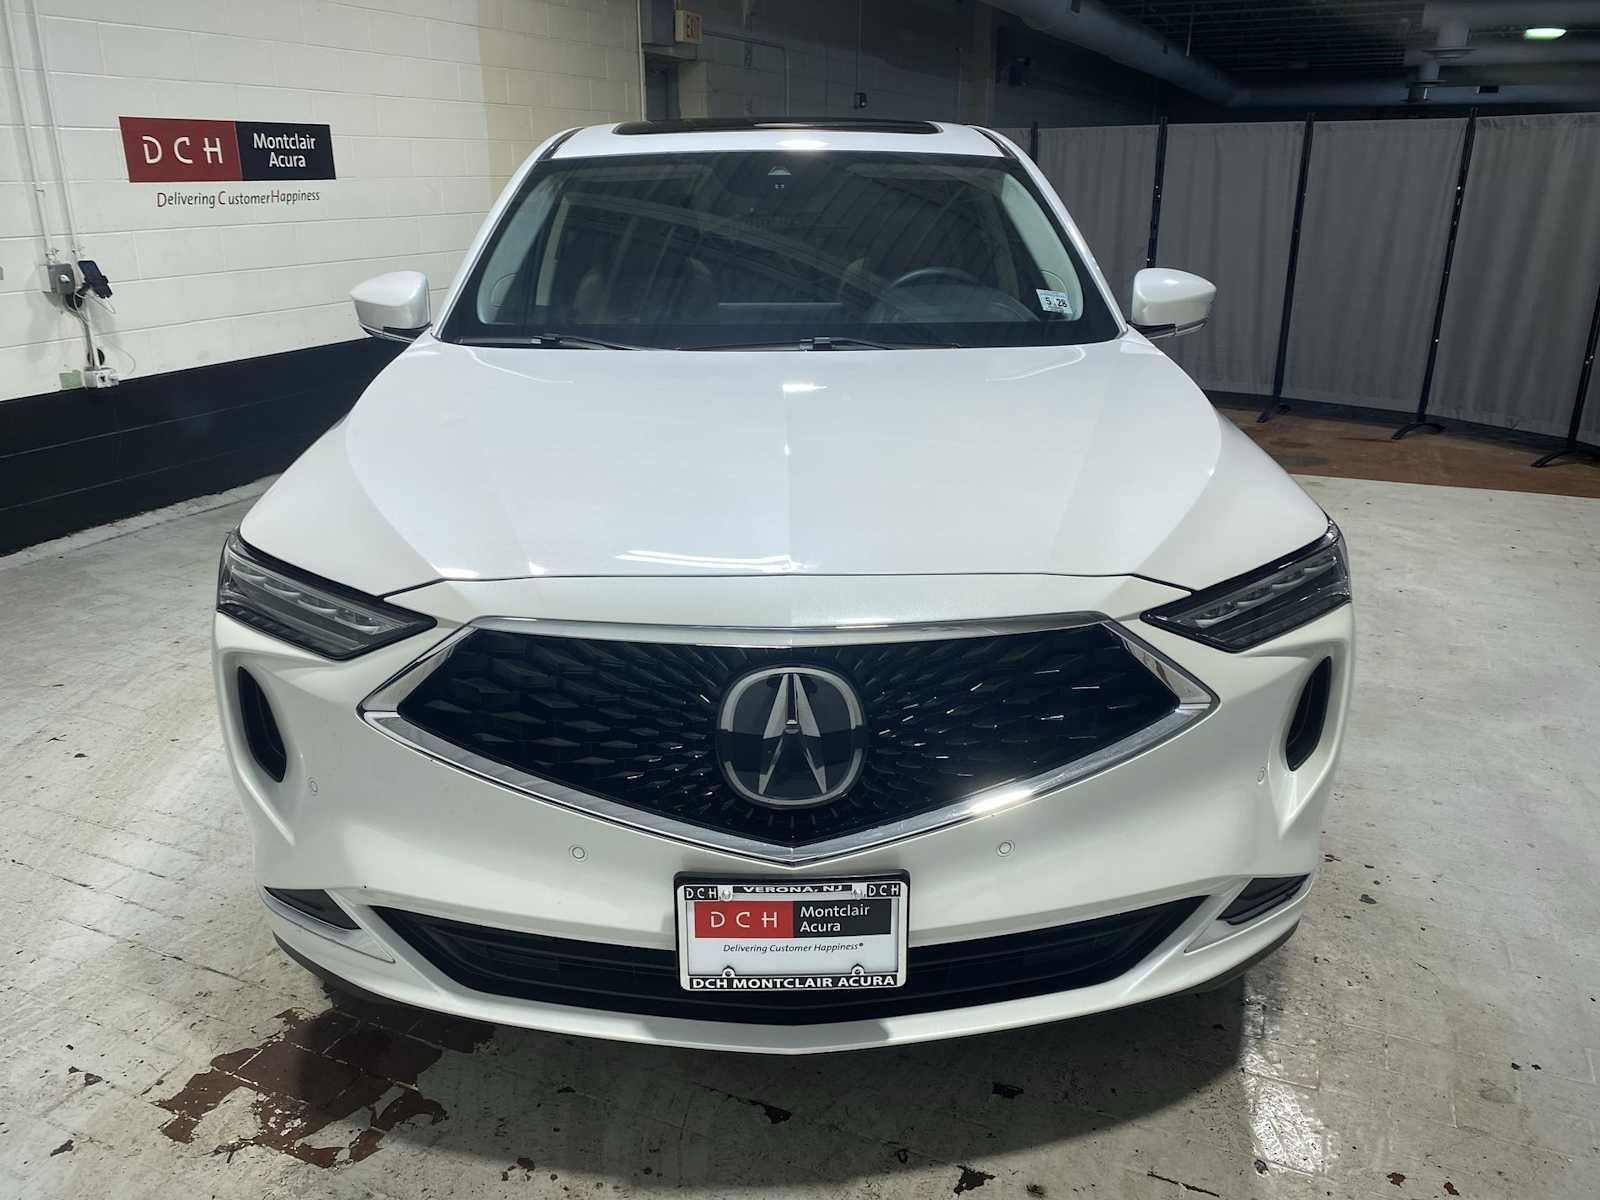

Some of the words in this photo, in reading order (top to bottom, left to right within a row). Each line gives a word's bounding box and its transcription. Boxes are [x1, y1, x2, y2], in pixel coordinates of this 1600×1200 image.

[253, 133, 316, 150] Montclair
[142, 136, 224, 164] DCH
[269, 152, 307, 168] Acura
[157, 192, 216, 209] Delivering
[685, 887, 718, 899] DCH
[744, 885, 819, 893] VERONA,
[868, 884, 900, 896] DCH
[800, 904, 870, 918] Montclair
[710, 911, 778, 928] DCH
[800, 921, 841, 933] Acura
[723, 943, 768, 954] Delivering
[770, 944, 811, 952] Customer
[692, 978, 731, 990] DCH
[733, 977, 833, 990] MONTCLAIR
[837, 975, 895, 988] ACURA
